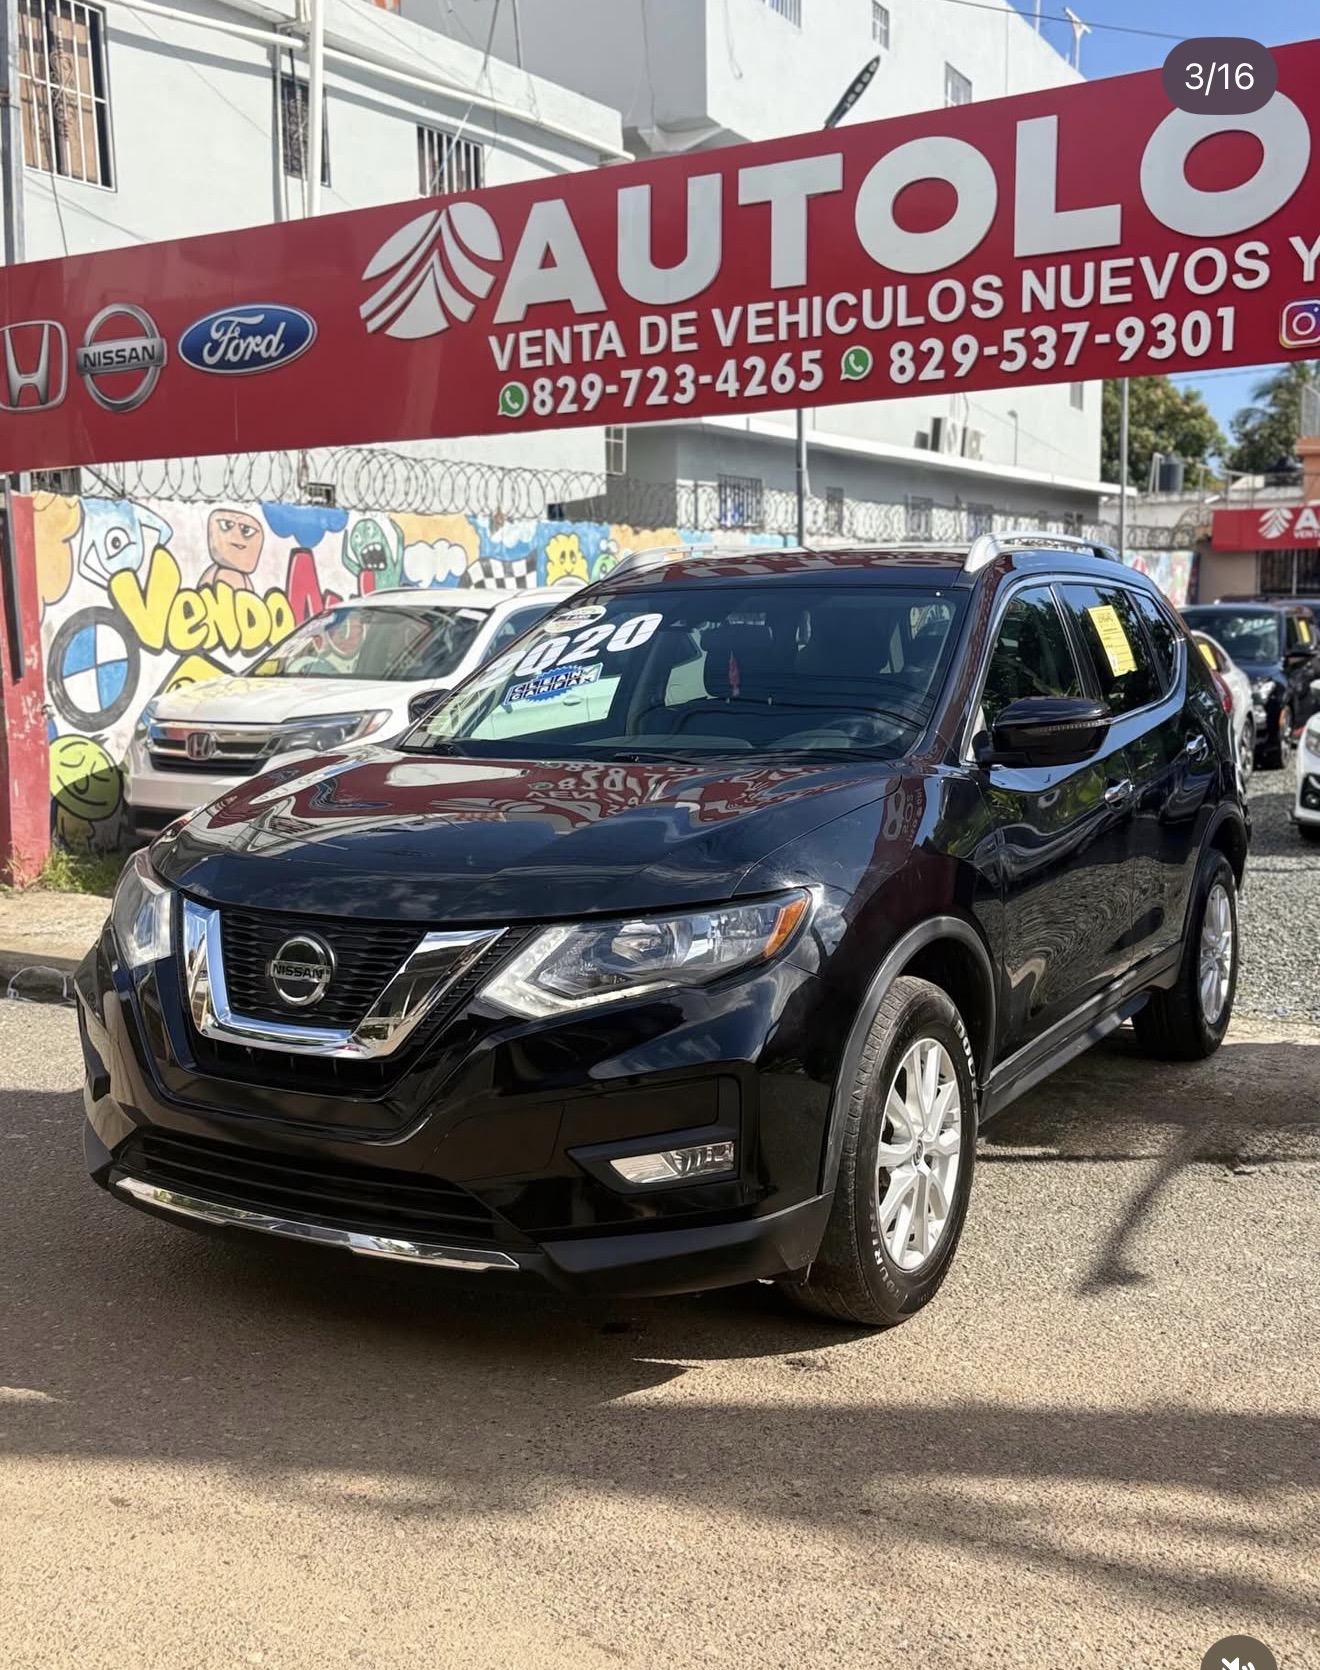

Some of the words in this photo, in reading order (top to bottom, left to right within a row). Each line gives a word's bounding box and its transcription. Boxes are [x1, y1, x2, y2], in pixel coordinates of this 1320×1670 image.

[493, 90, 1311, 324] AUTOLO
[488, 319, 627, 372] VENTA
[639, 311, 699, 355] DE
[711, 274, 1004, 348] VEHICULOS
[1021, 240, 1271, 314] NUEVOS
[1289, 234, 1320, 283] Y
[83, 344, 156, 368] NISSAN
[203, 313, 287, 365] Ford
[532, 349, 825, 416] 829-723-4265
[889, 306, 1236, 385] 829-537-9301
[511, 675, 596, 700] CARFAX
[514, 670, 582, 693] CLEAN
[272, 963, 324, 980] NISSAN
